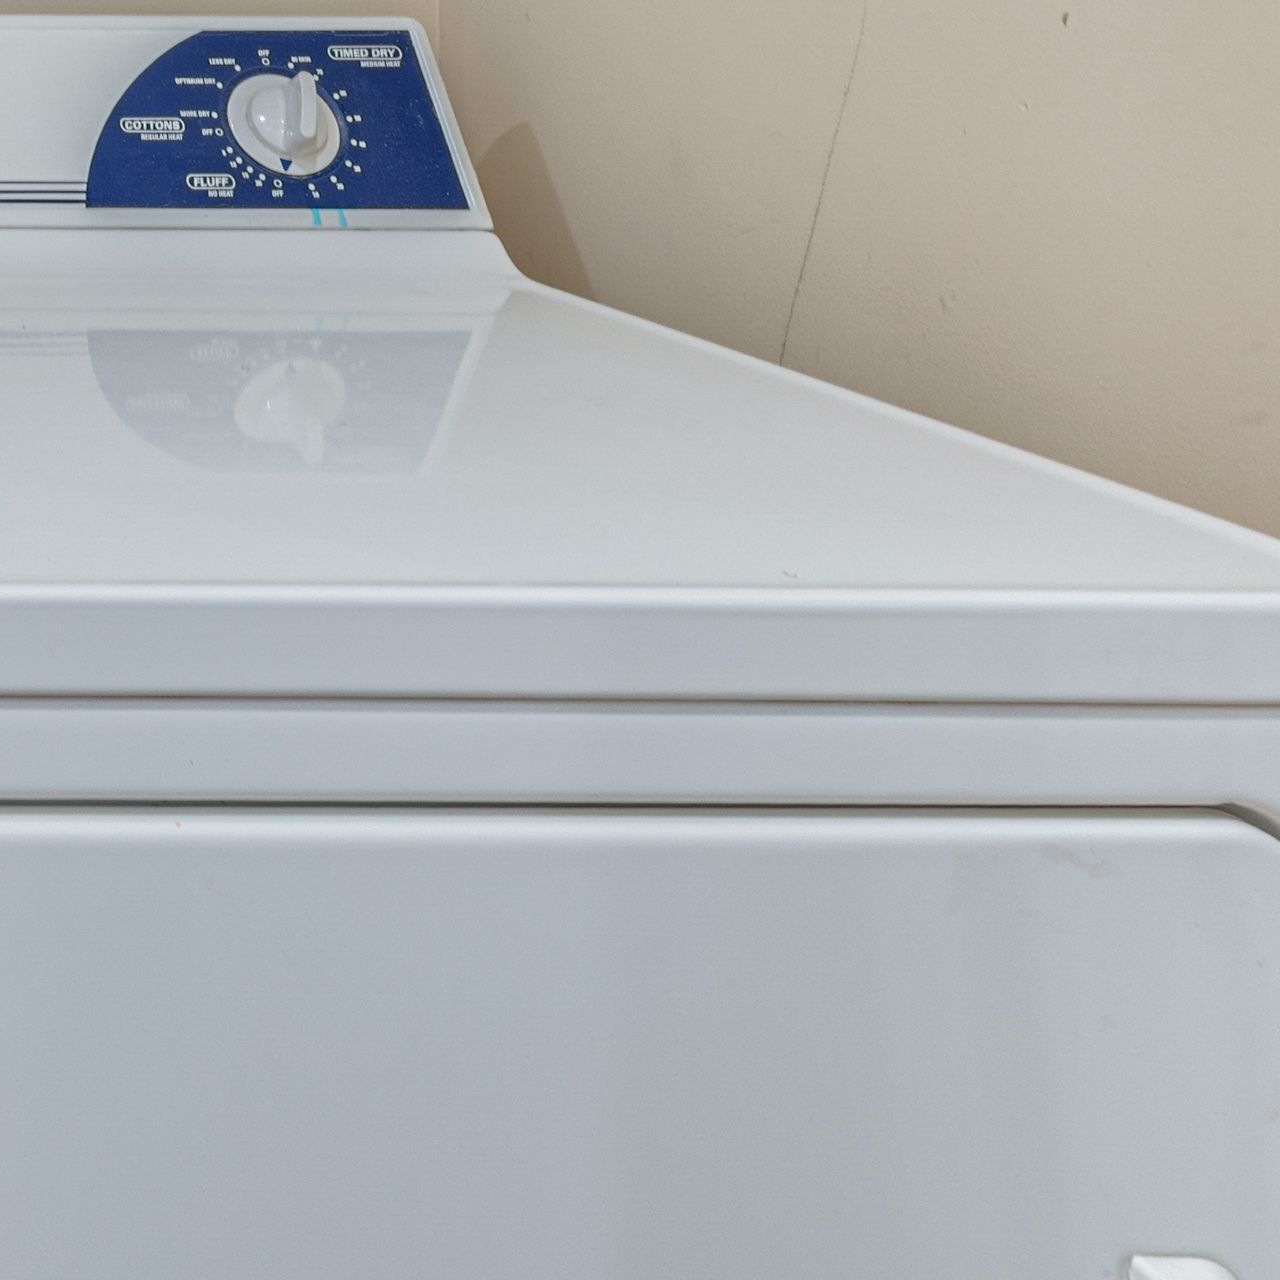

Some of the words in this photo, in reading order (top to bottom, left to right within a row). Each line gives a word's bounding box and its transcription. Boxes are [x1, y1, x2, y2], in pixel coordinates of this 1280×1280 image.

[333, 48, 368, 57] TIMED
[371, 48, 395, 58] DRY
[125, 121, 180, 130] COTTONS
[202, 128, 213, 136] OFF
[193, 176, 229, 187] FLUFF
[272, 190, 284, 198] OFF
